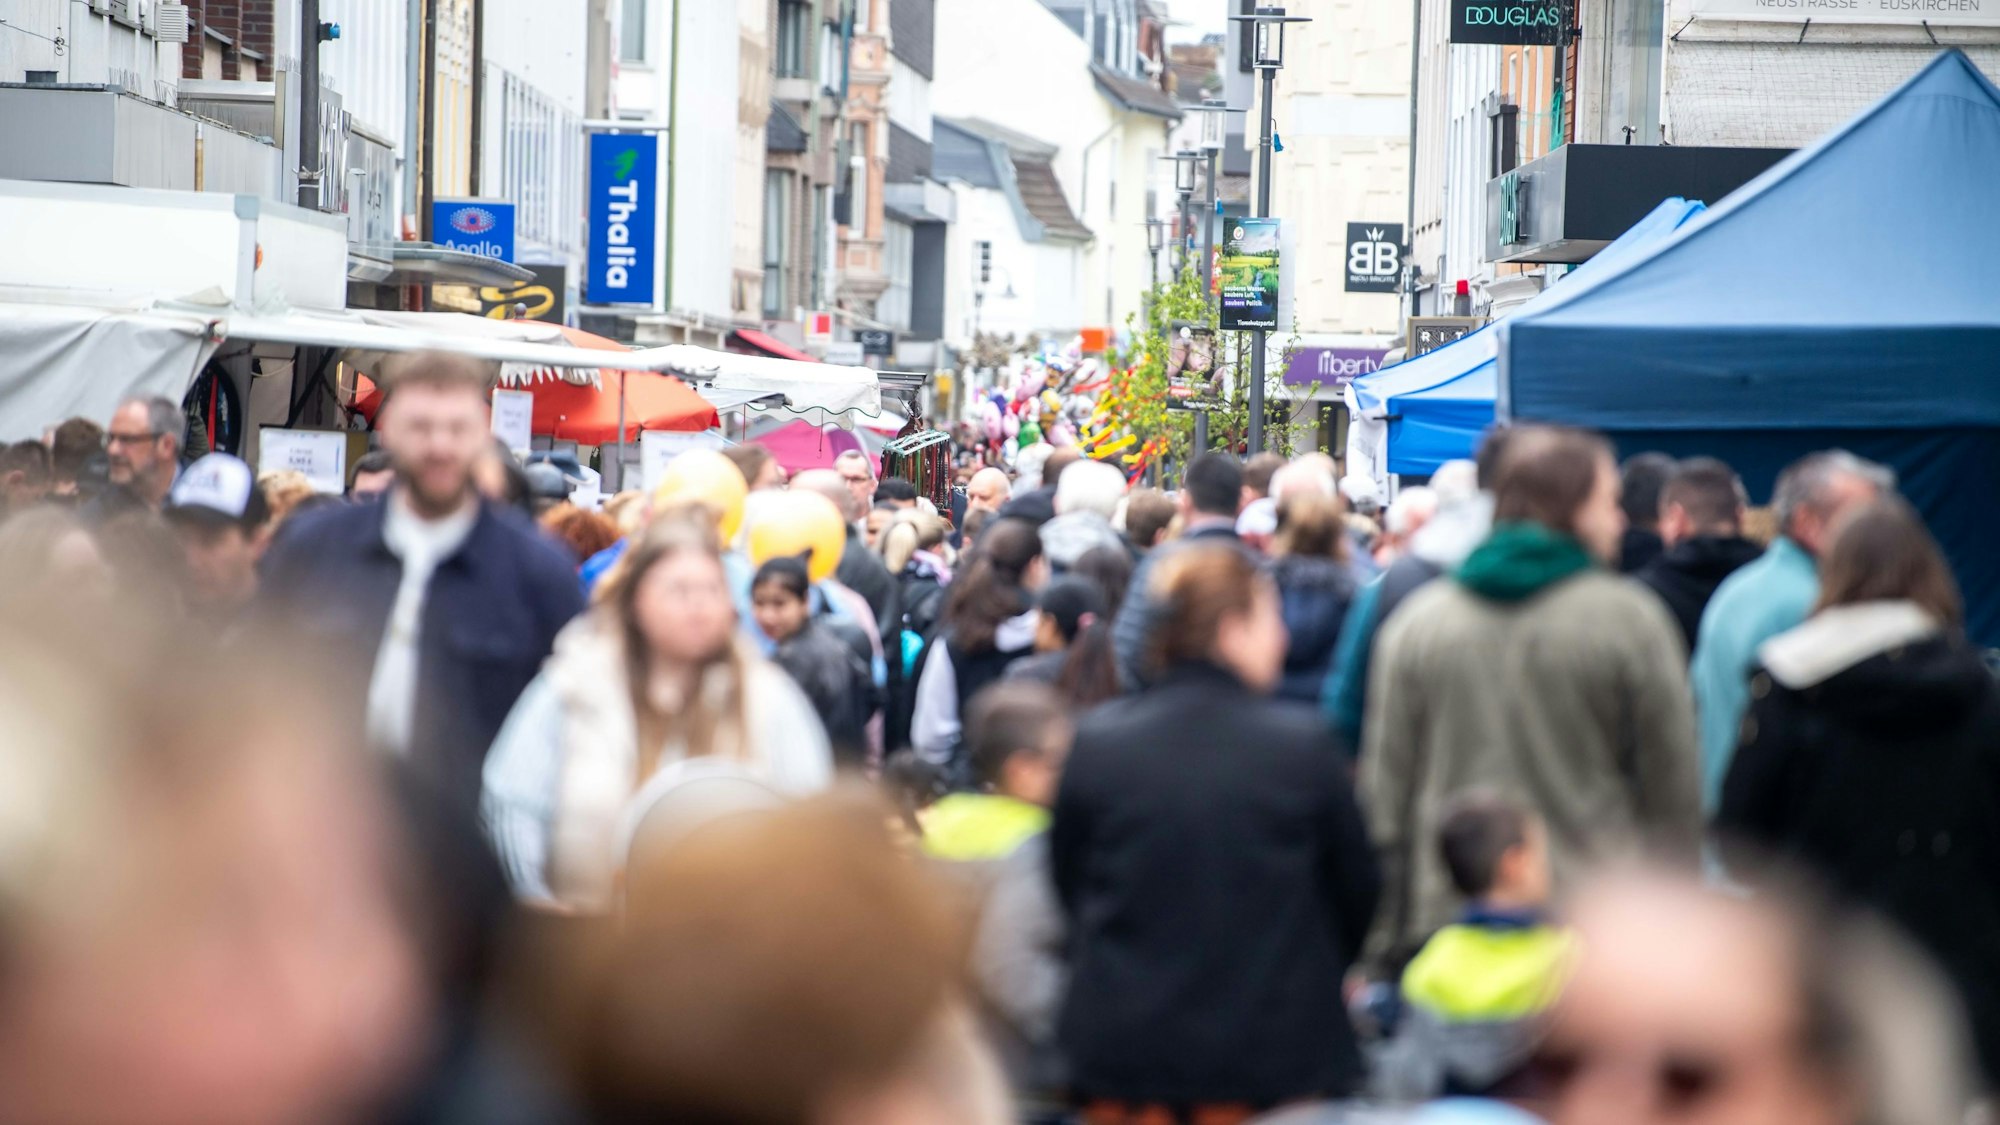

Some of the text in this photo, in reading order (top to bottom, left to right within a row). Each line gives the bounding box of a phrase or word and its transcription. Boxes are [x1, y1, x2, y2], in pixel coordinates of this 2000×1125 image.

[1465, 6, 1559, 26] DOUGLAS
[1880, 0, 1980, 11] EUSKIRCHEN
[606, 179, 638, 289] Thalia
[1318, 350, 1383, 376] liberty
